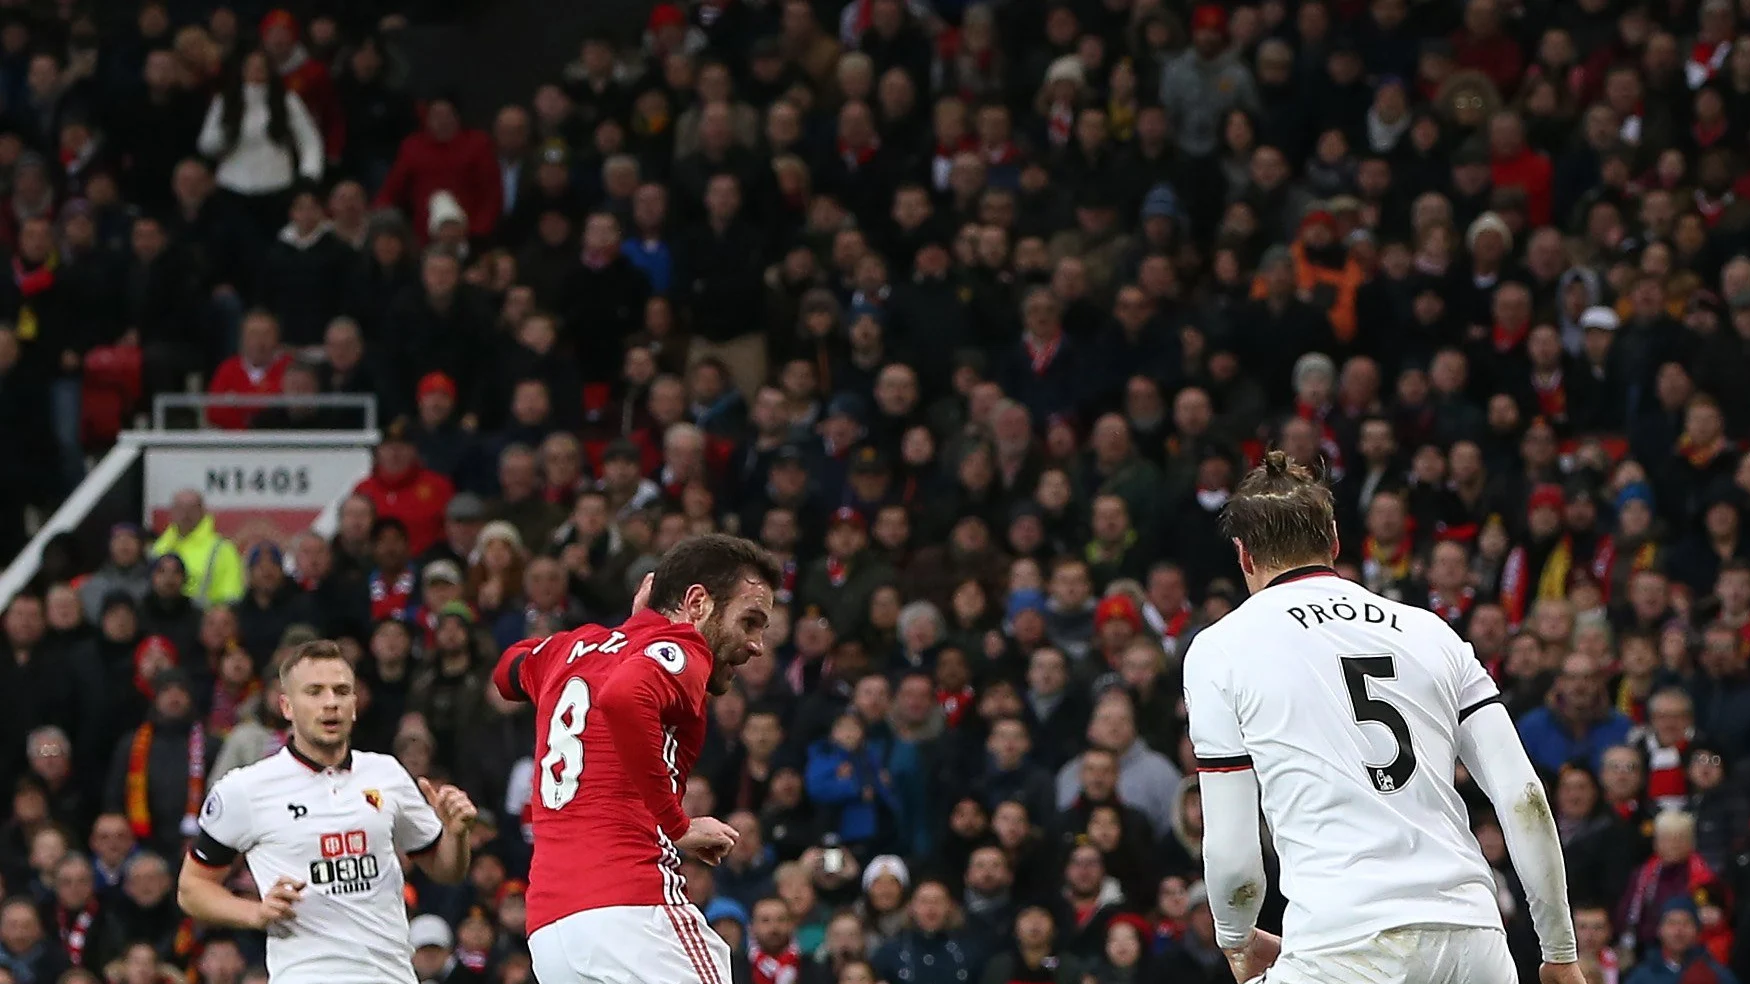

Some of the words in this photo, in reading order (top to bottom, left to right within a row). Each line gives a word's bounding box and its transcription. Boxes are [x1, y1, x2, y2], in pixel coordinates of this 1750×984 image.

[206, 467, 311, 494] N1405
[1287, 596, 1403, 632] PRÖDL
[540, 676, 591, 810] 8
[1338, 654, 1418, 794] 5
